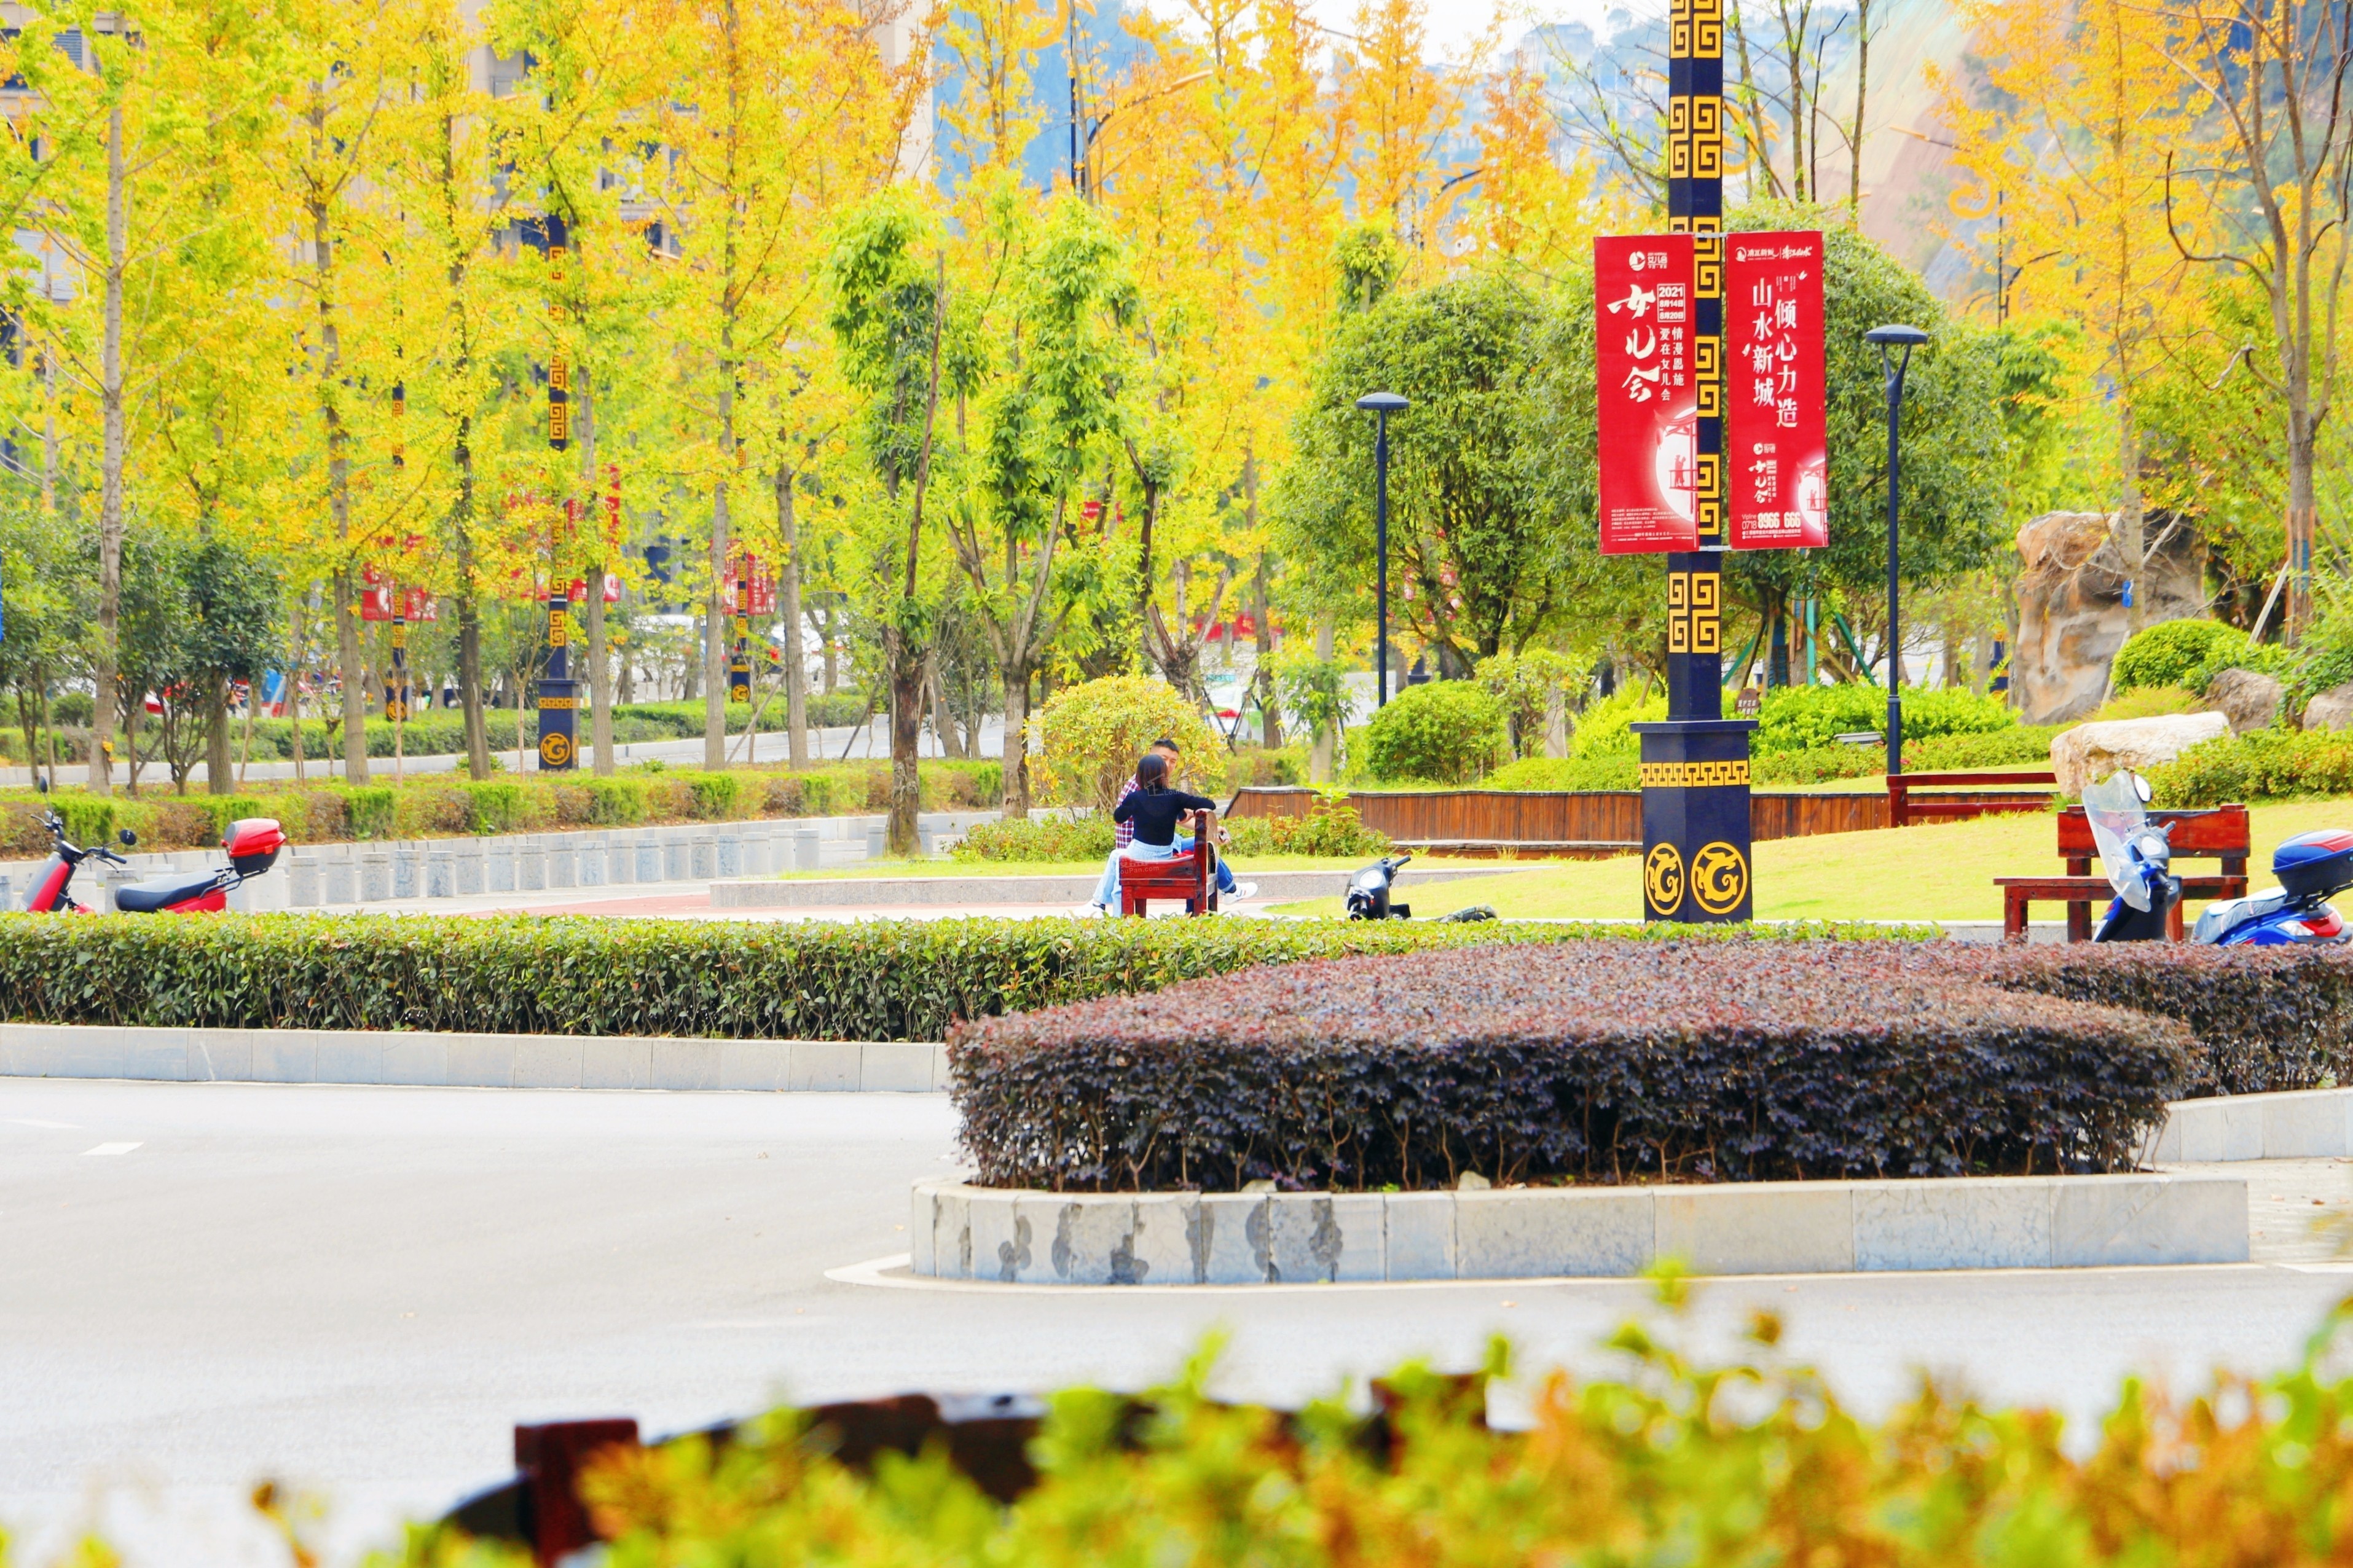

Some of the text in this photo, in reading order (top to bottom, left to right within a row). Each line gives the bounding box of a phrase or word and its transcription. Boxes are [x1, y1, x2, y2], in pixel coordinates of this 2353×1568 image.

[1659, 286, 1683, 297] 2021
[1606, 284, 1660, 402] 女儿会
[1660, 327, 1671, 401] 爱在女儿会
[1672, 326, 1684, 386] 情漫恩施
[1753, 278, 1775, 407] 山水新城
[1775, 299, 1798, 428] 倾心力造
[1742, 511, 1801, 530] 0718 8966 666
